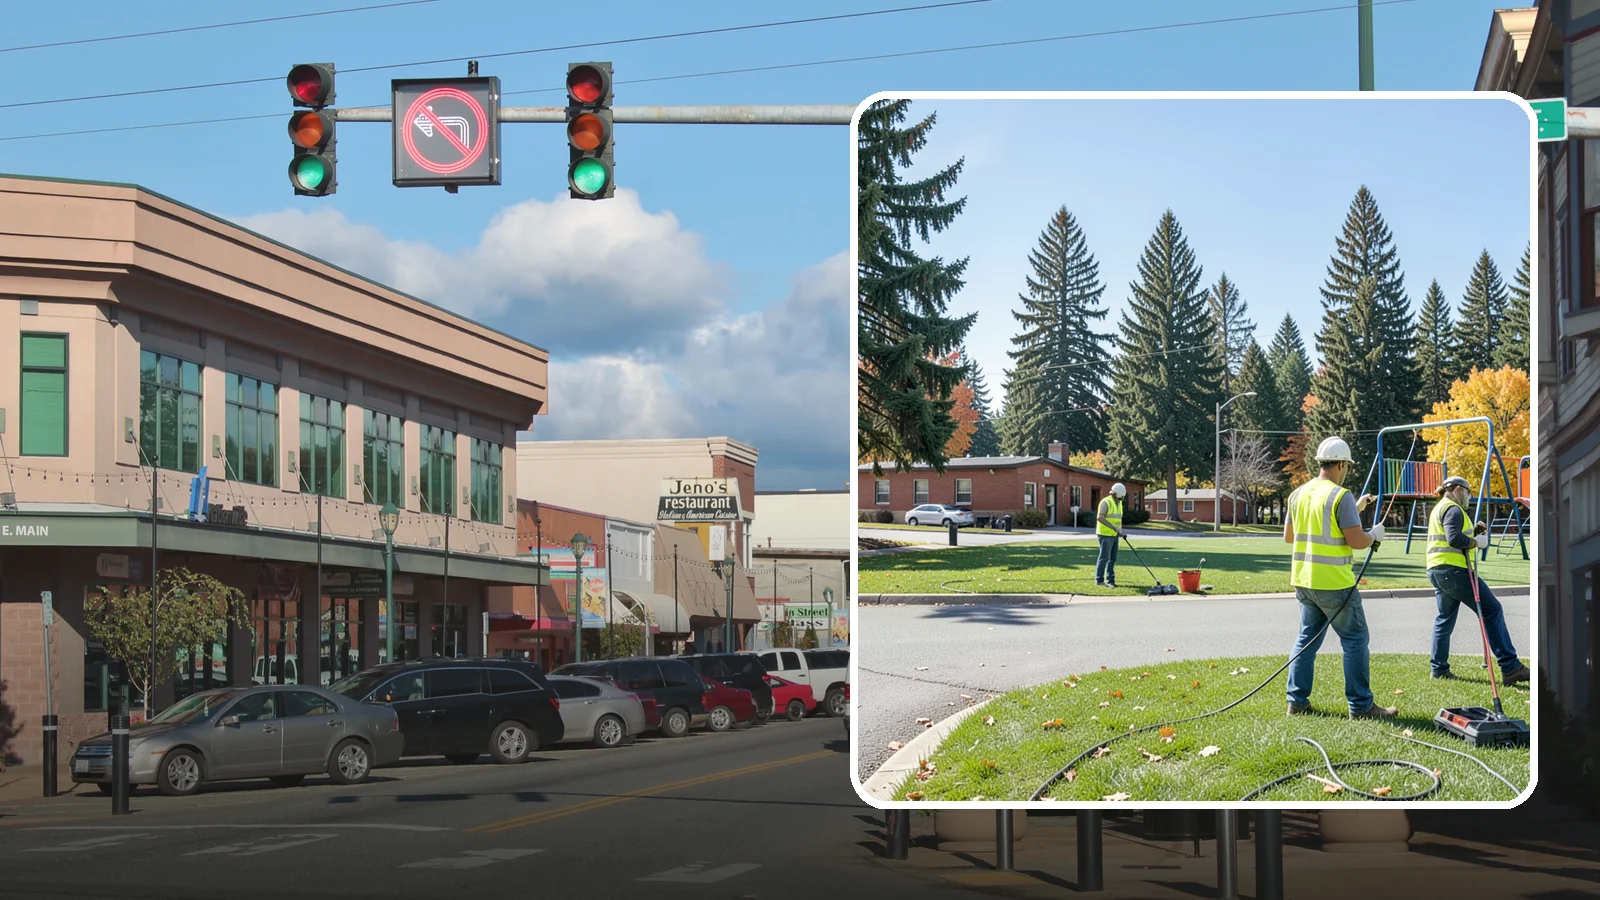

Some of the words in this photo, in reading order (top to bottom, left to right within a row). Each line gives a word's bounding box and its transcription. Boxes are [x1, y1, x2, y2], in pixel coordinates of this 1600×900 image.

[670, 480, 727, 494] Jeno's
[665, 496, 731, 509] restaurant
[659, 510, 681, 519] Italian
[686, 510, 714, 519] American
[715, 509, 737, 519] Cuisine
[2, 525, 13, 536] E.
[15, 525, 49, 536] MAIN
[797, 607, 828, 617] Street
